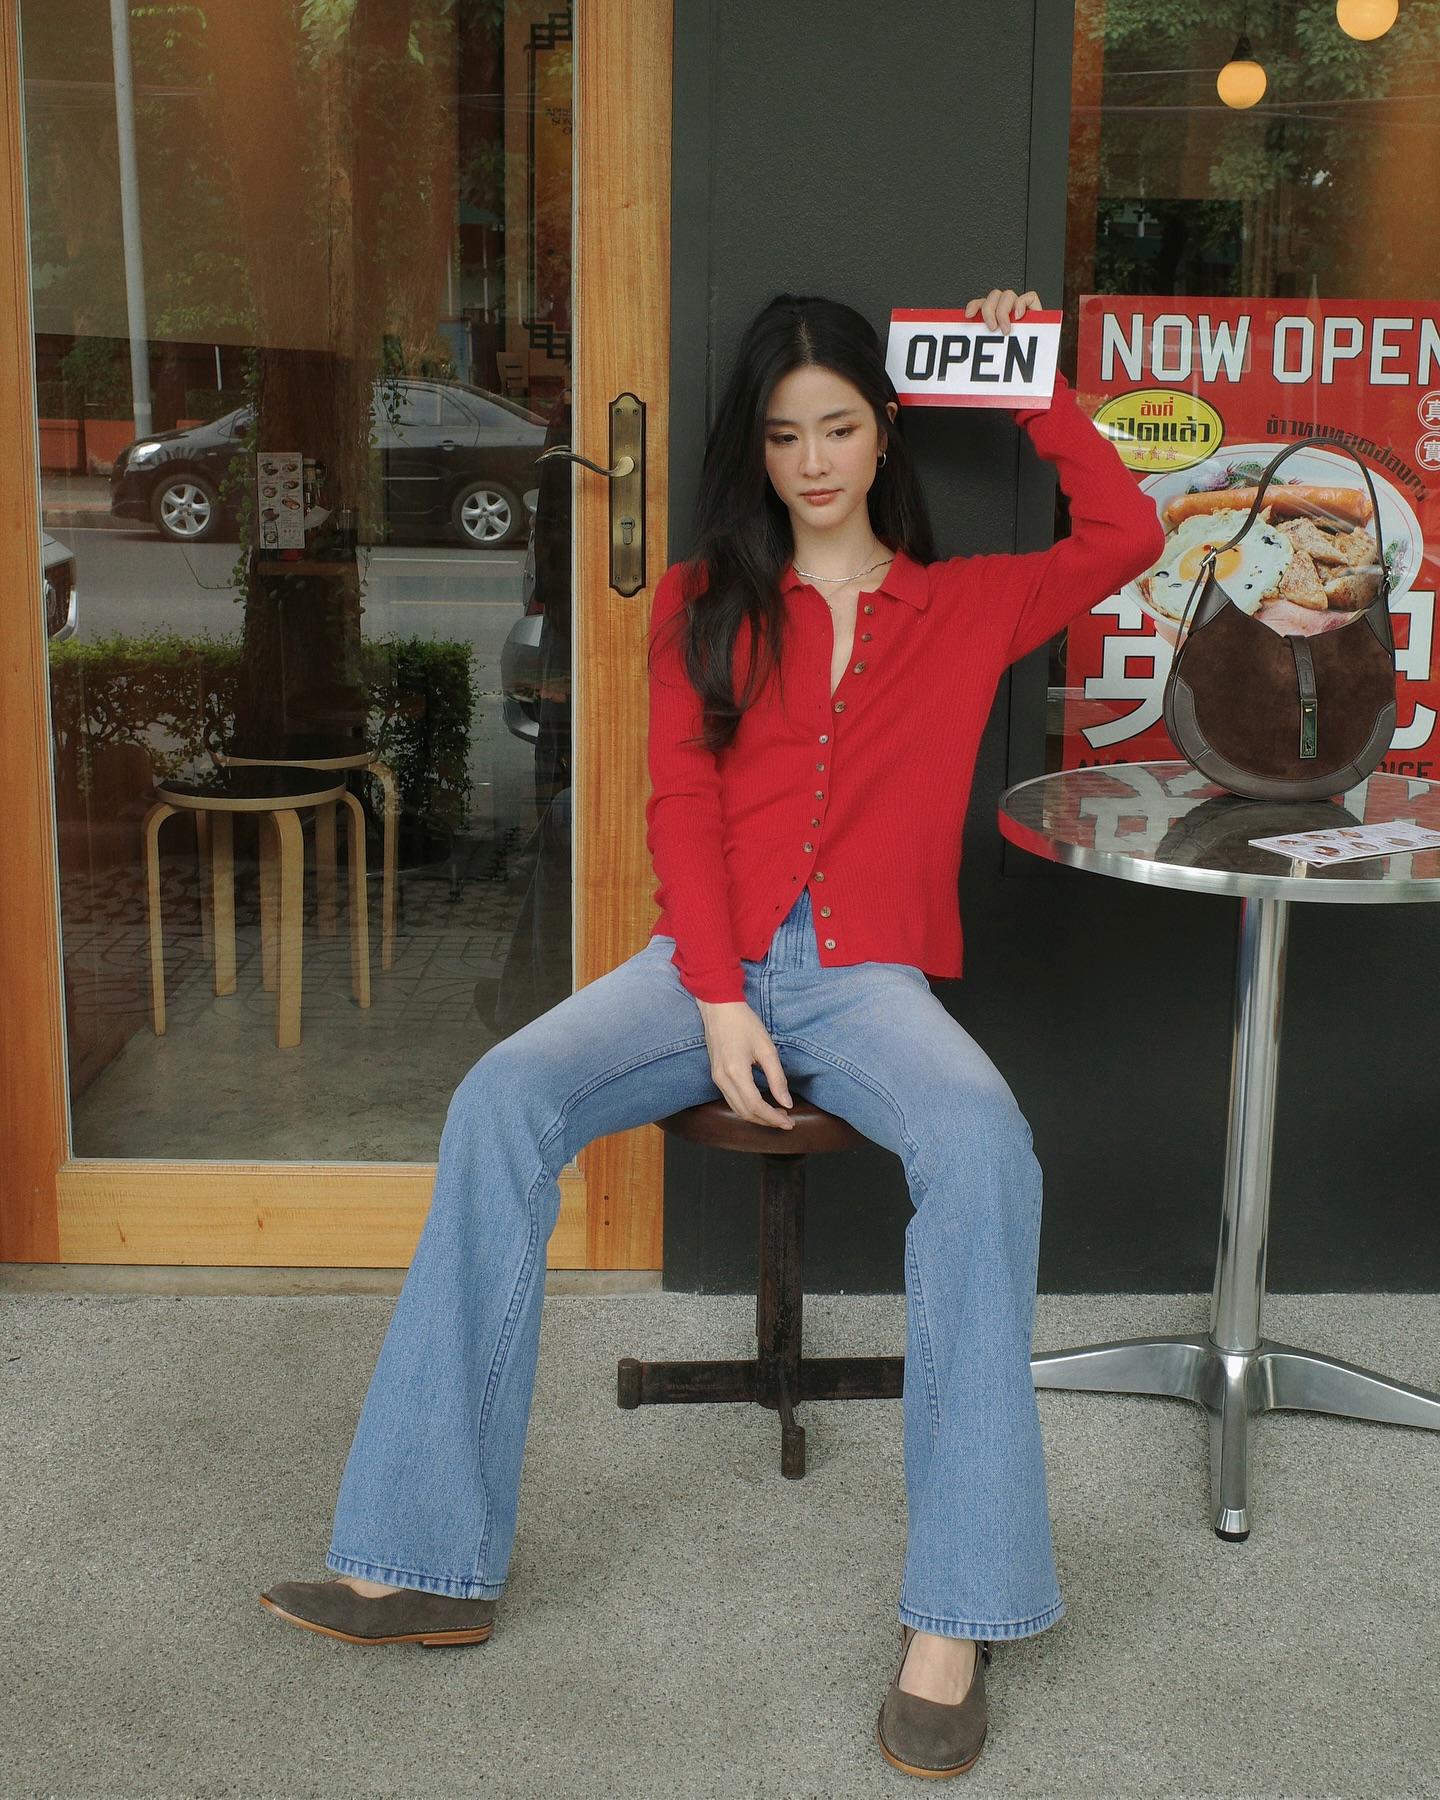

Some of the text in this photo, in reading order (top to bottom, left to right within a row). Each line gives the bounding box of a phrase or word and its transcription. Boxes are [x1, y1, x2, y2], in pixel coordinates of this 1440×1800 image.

[905, 335, 1039, 383] OPEN
[1101, 313, 1252, 383] NOW
[1108, 415, 1211, 443] เปิดแล้ว
